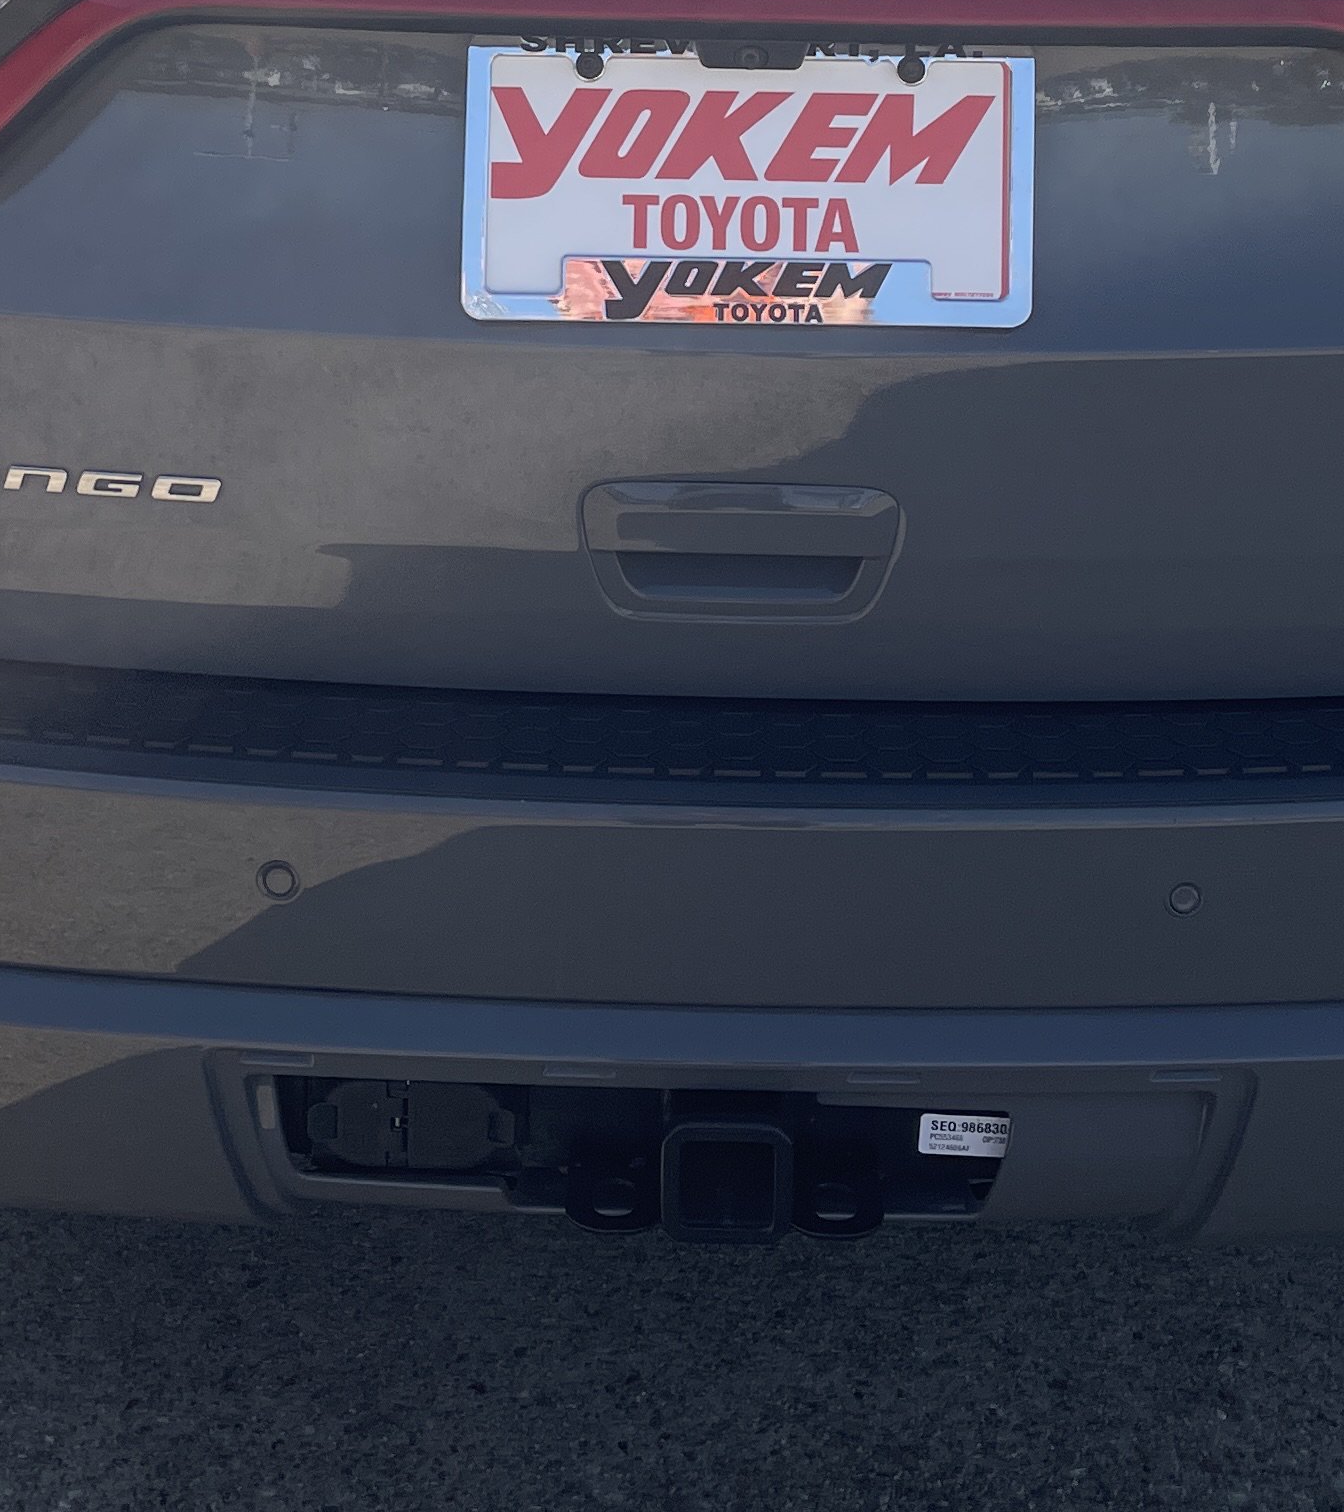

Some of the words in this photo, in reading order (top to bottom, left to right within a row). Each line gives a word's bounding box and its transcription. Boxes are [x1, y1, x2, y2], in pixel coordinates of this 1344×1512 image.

[490, 86, 997, 199] YOKEM
[622, 193, 860, 253] TOYOTA
[602, 259, 893, 320] YOKEM
[713, 301, 824, 323] TOYOTA
